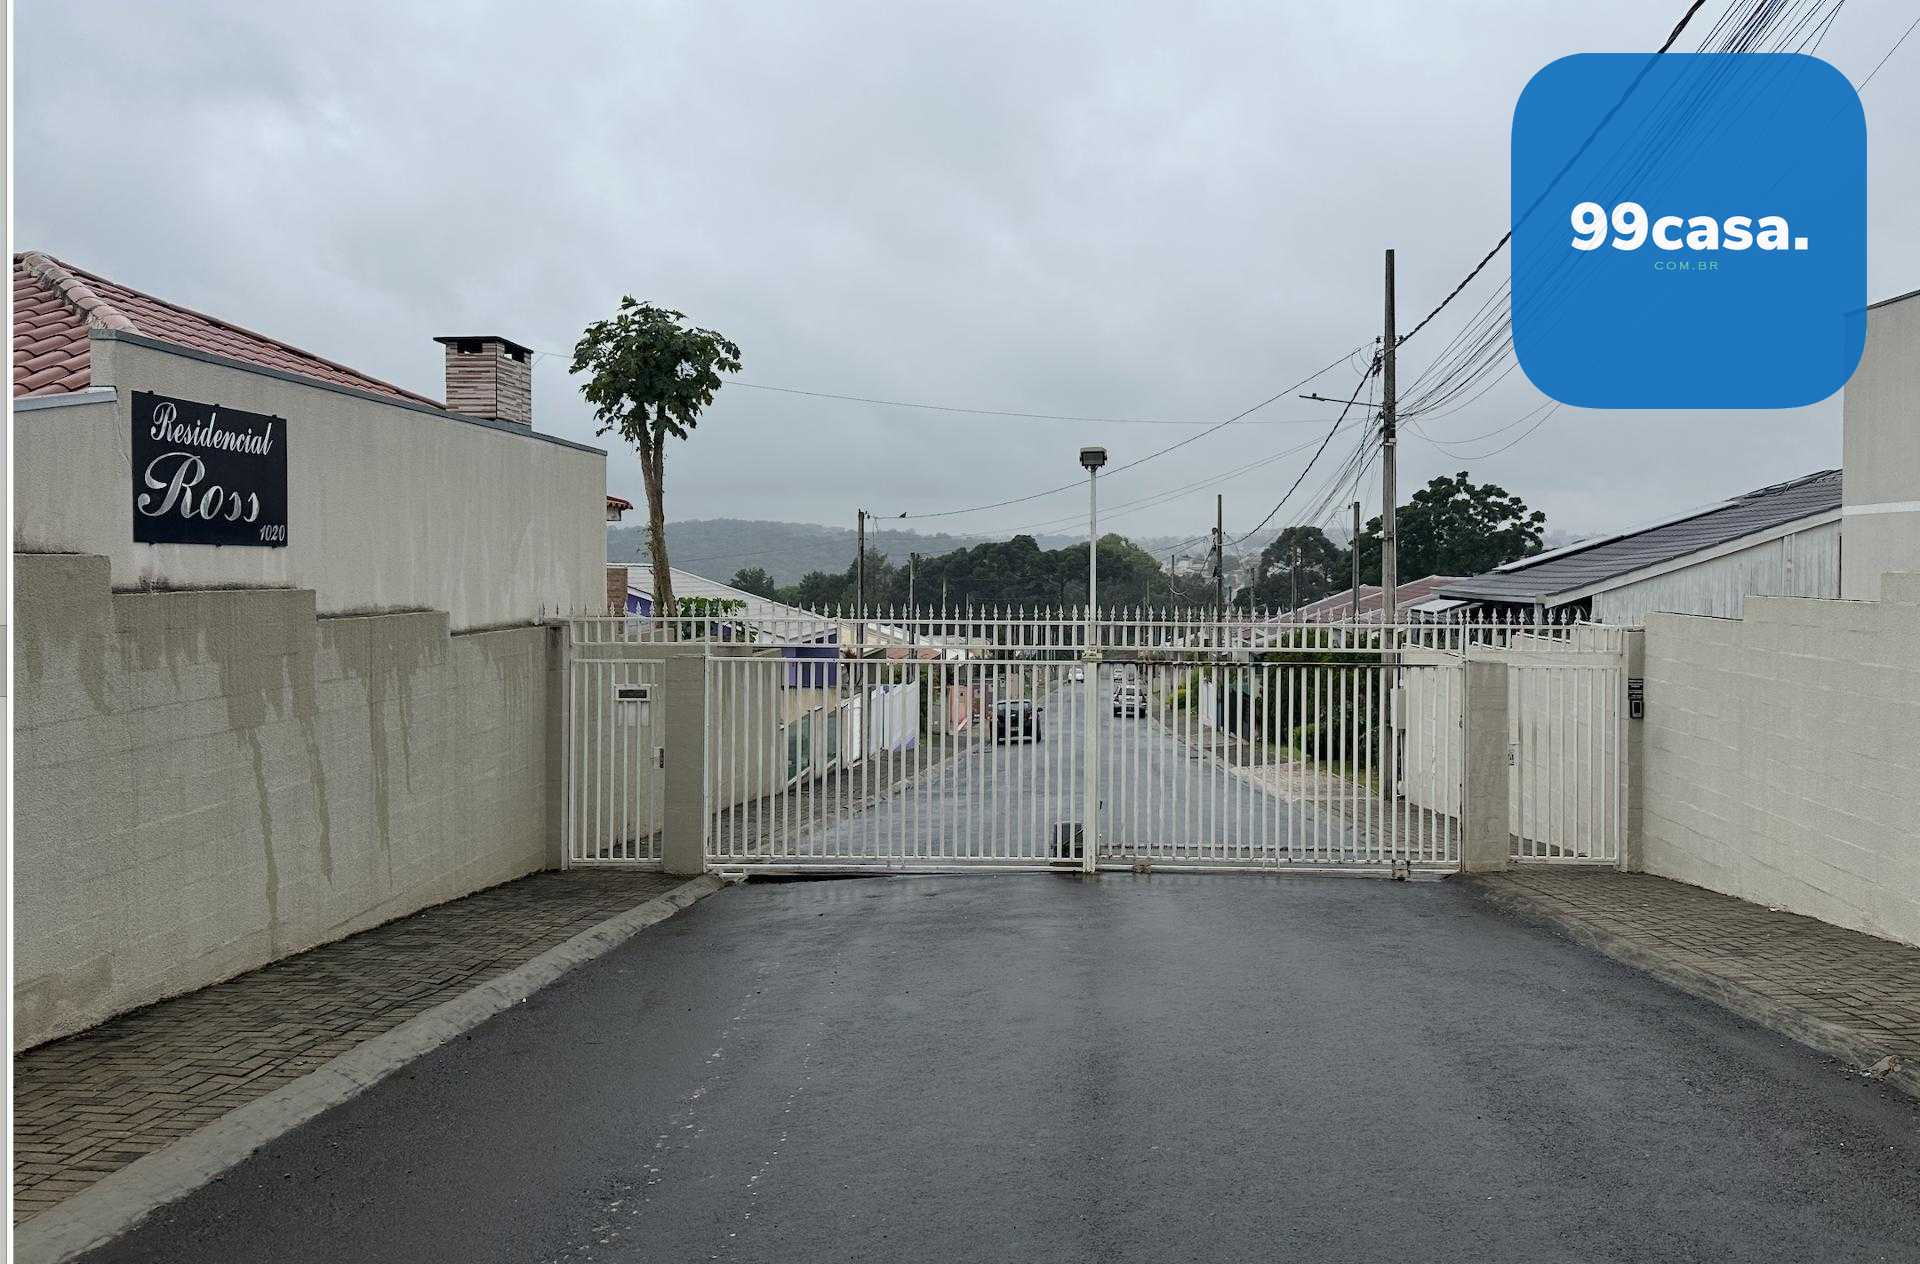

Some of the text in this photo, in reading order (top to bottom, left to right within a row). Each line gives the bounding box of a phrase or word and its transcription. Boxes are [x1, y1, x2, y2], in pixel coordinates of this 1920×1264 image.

[150, 402, 273, 456] Residencial
[137, 451, 260, 522] Ross
[259, 524, 286, 541] 1020
